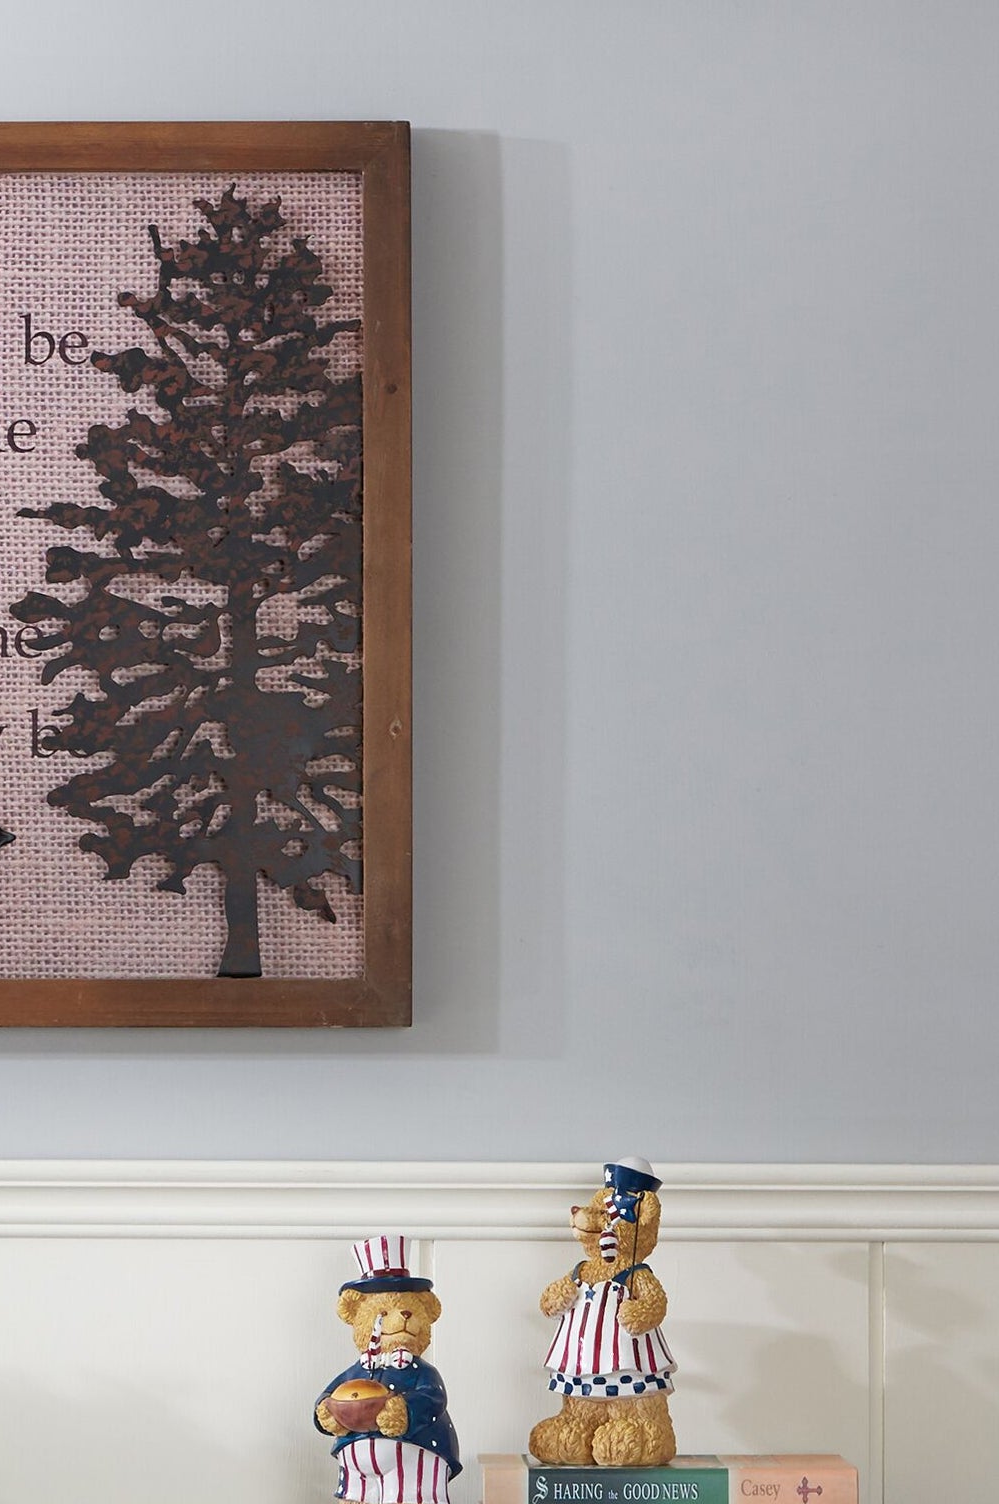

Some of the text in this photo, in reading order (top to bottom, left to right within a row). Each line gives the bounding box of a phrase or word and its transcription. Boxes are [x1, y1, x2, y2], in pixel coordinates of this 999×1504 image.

[22, 314, 89, 366] be
[27, 708, 93, 758] b
[608, 1490, 619, 1501] the
[623, 1483, 661, 1501] GOOD
[662, 1483, 699, 1501] NEWS
[740, 1478, 781, 1501] Casey
